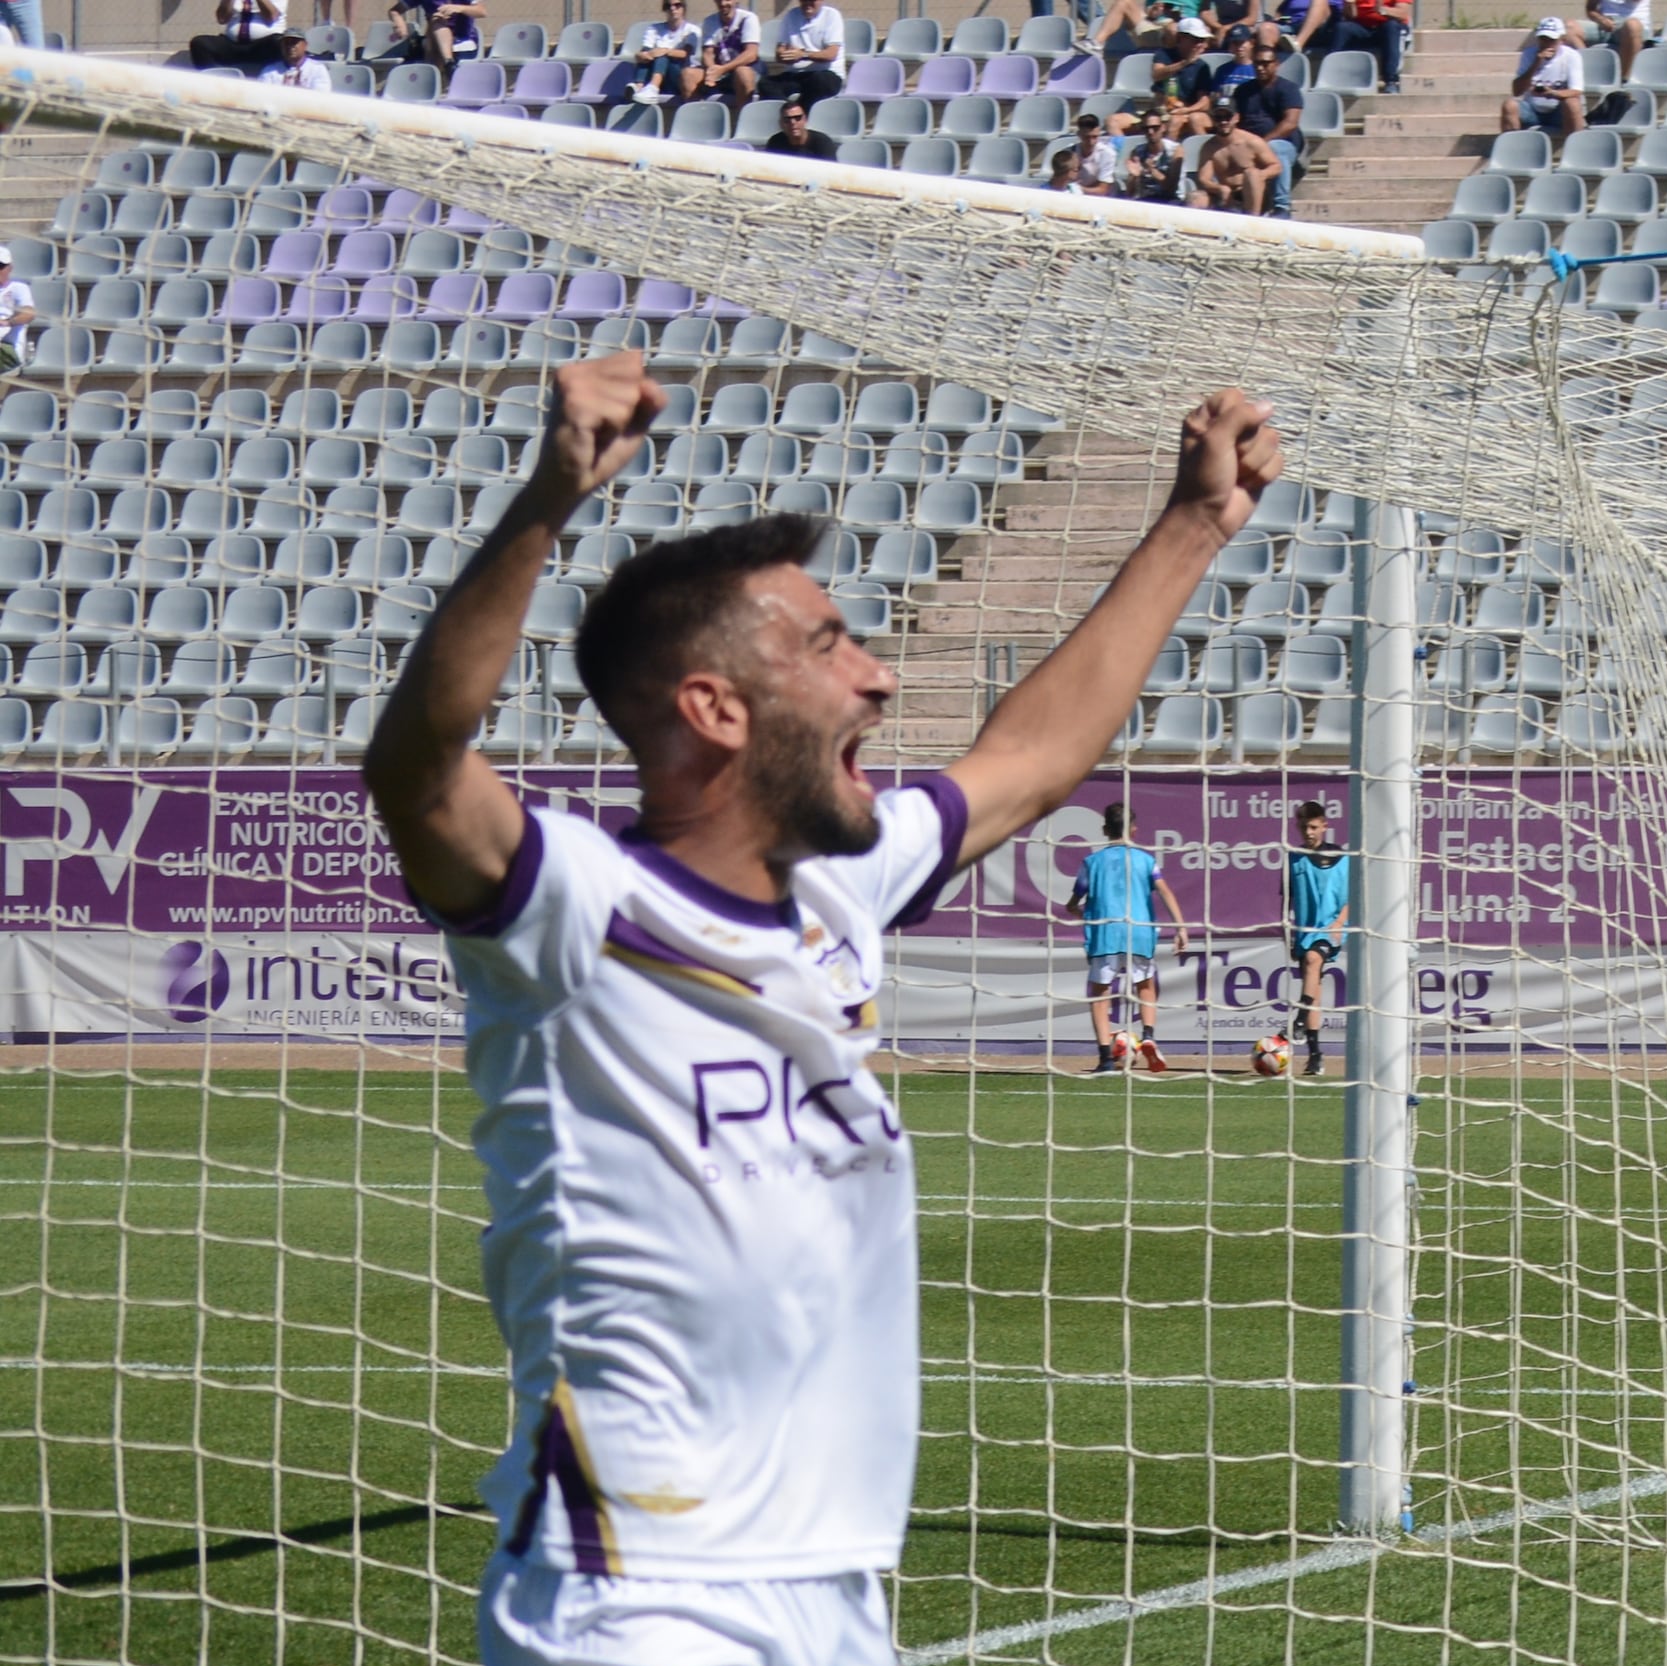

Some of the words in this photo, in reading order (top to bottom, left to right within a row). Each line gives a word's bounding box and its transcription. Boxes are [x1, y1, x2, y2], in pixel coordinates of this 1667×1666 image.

[214, 792, 358, 817] EXPERTOS
[1209, 791, 1239, 818] Tu
[1412, 793, 1543, 820] onfianza
[1555, 799, 1590, 820] en
[230, 817, 391, 847] NUTRICIÓN
[158, 846, 270, 877] CLÍNICA
[303, 852, 403, 877] DEPOR
[1155, 830, 1285, 870] Paseo
[1439, 831, 1635, 873] Estación
[168, 901, 427, 930] www.npvnutrition.co
[1422, 883, 1531, 923] Luna
[1548, 883, 1577, 923] 2
[246, 940, 466, 1002] intele
[247, 1007, 361, 1027] INGENIERÍA
[370, 1004, 465, 1029] ENERGÉT
